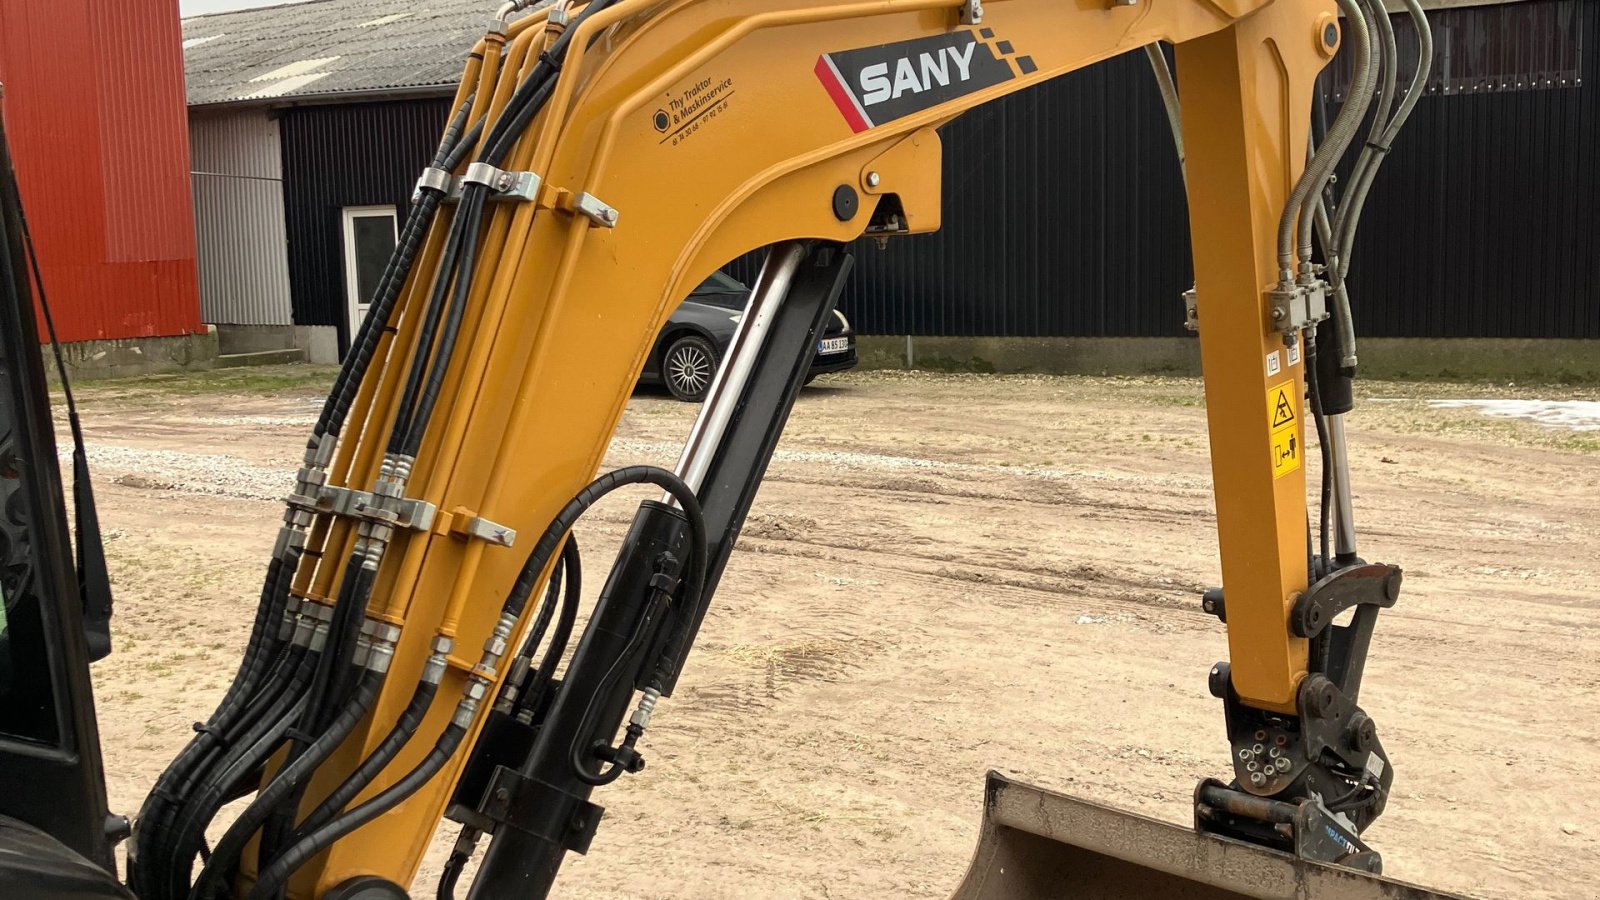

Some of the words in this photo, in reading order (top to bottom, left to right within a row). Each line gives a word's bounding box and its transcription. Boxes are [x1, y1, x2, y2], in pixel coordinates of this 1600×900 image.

[669, 98, 684, 111] Thy
[684, 76, 712, 101] Traktor
[860, 41, 976, 106] SANY
[673, 114, 680, 124] &
[680, 78, 732, 120] Maskinservice
[823, 341, 830, 350] AA
